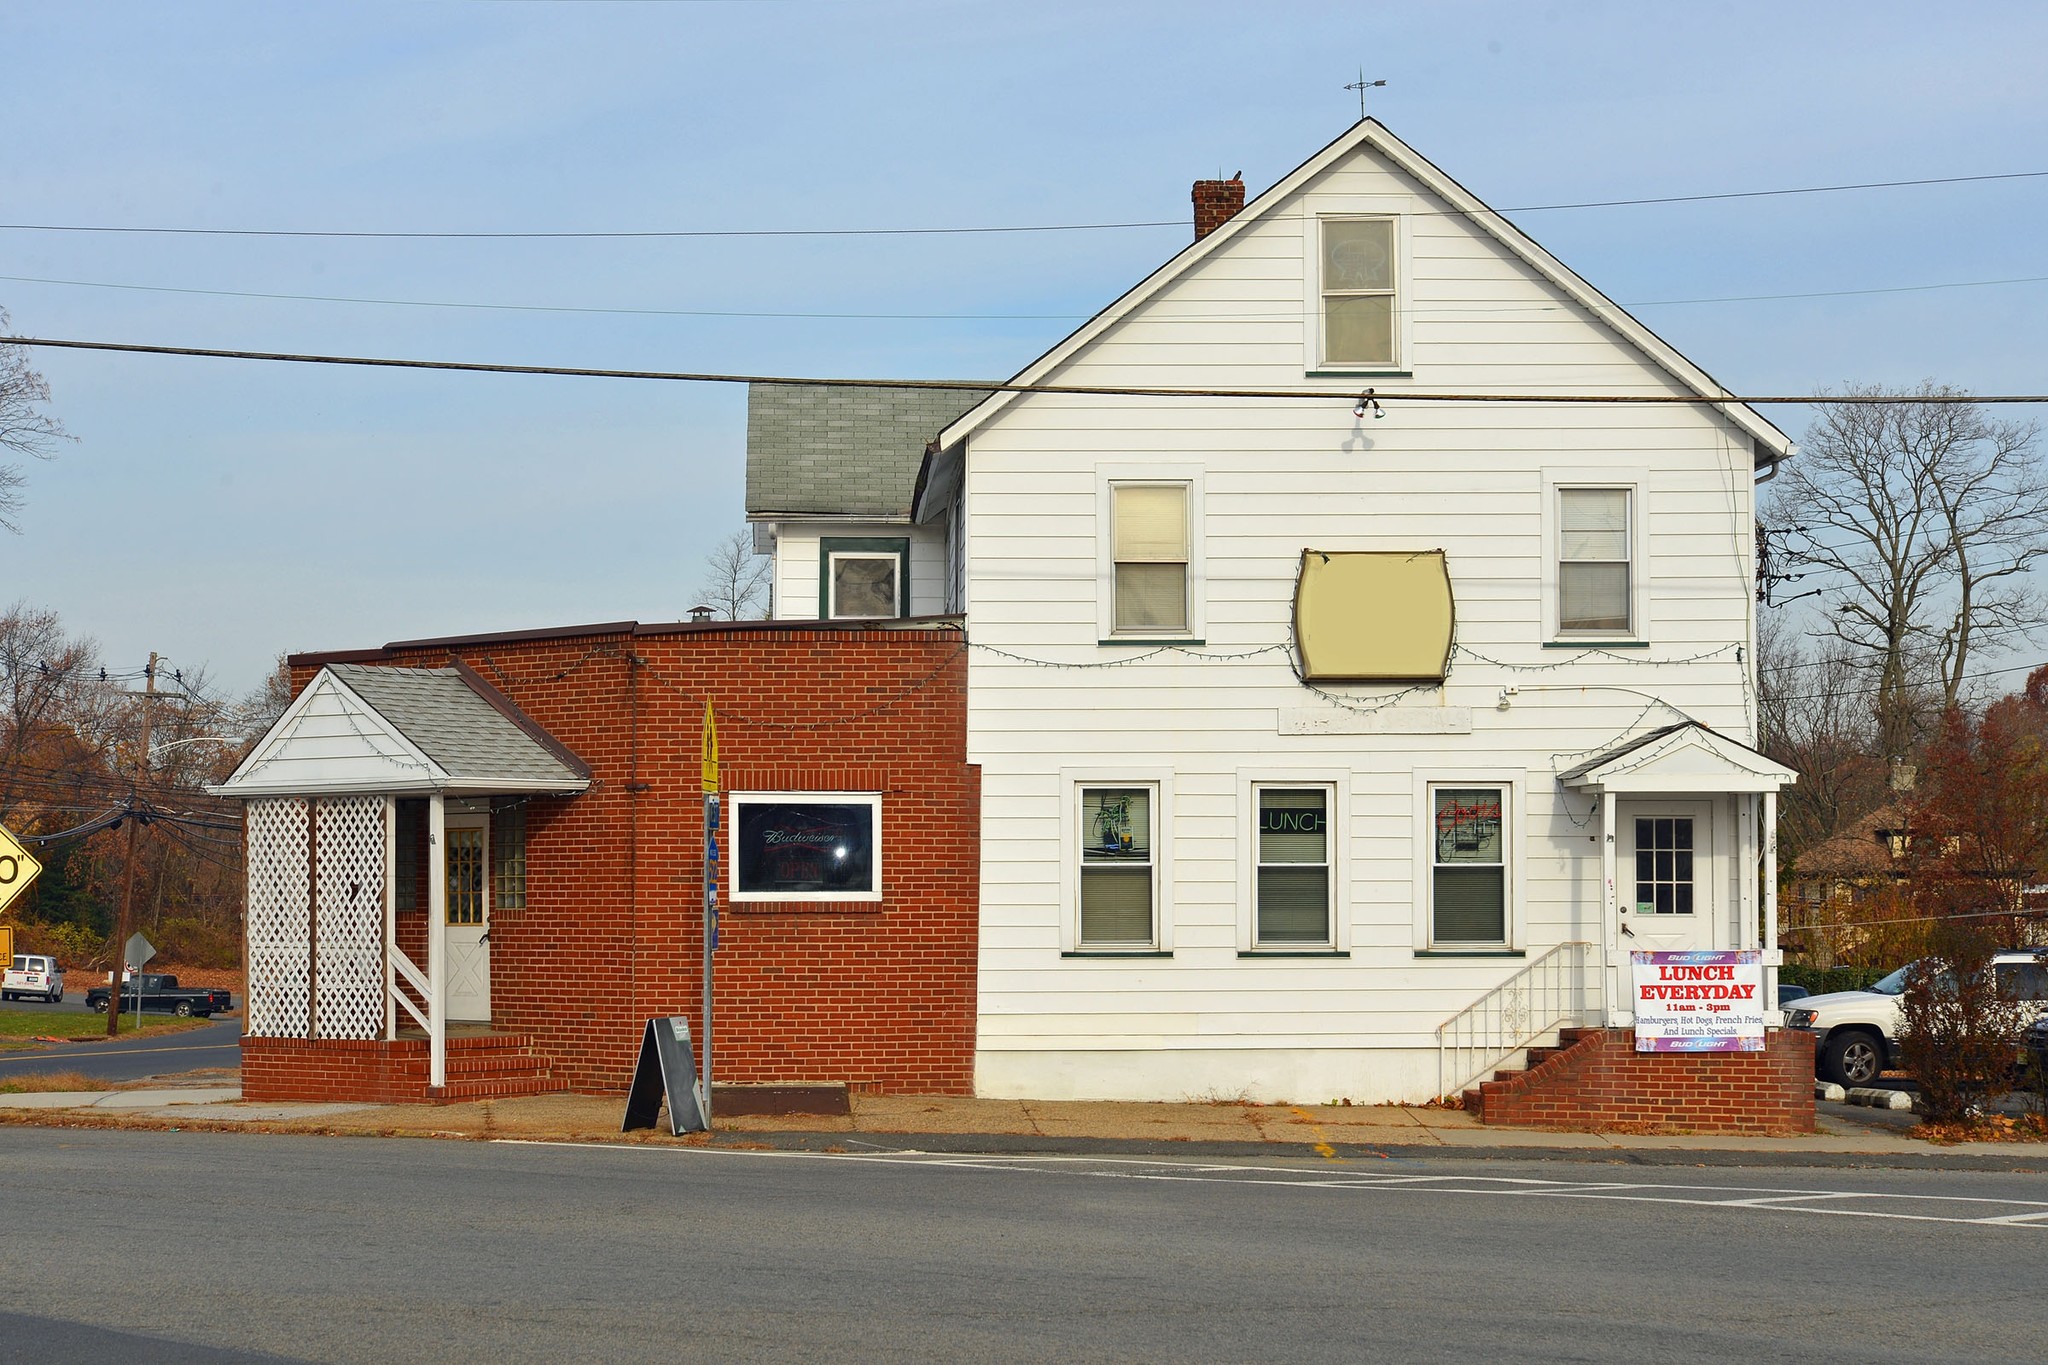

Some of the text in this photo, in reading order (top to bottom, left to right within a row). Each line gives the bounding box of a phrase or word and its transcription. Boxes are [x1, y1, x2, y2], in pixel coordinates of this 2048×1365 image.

[1437, 800, 1502, 832] Coors
[763, 830, 836, 844] Budweiser
[1659, 966, 1734, 980] LUNCH
[1640, 985, 1756, 999] EVERYDAY
[1706, 1004, 1731, 1013] 3pm
[1716, 1015, 1742, 1024] French
[1664, 1027, 1679, 1035] And
[1682, 1027, 1704, 1035] Lunch
